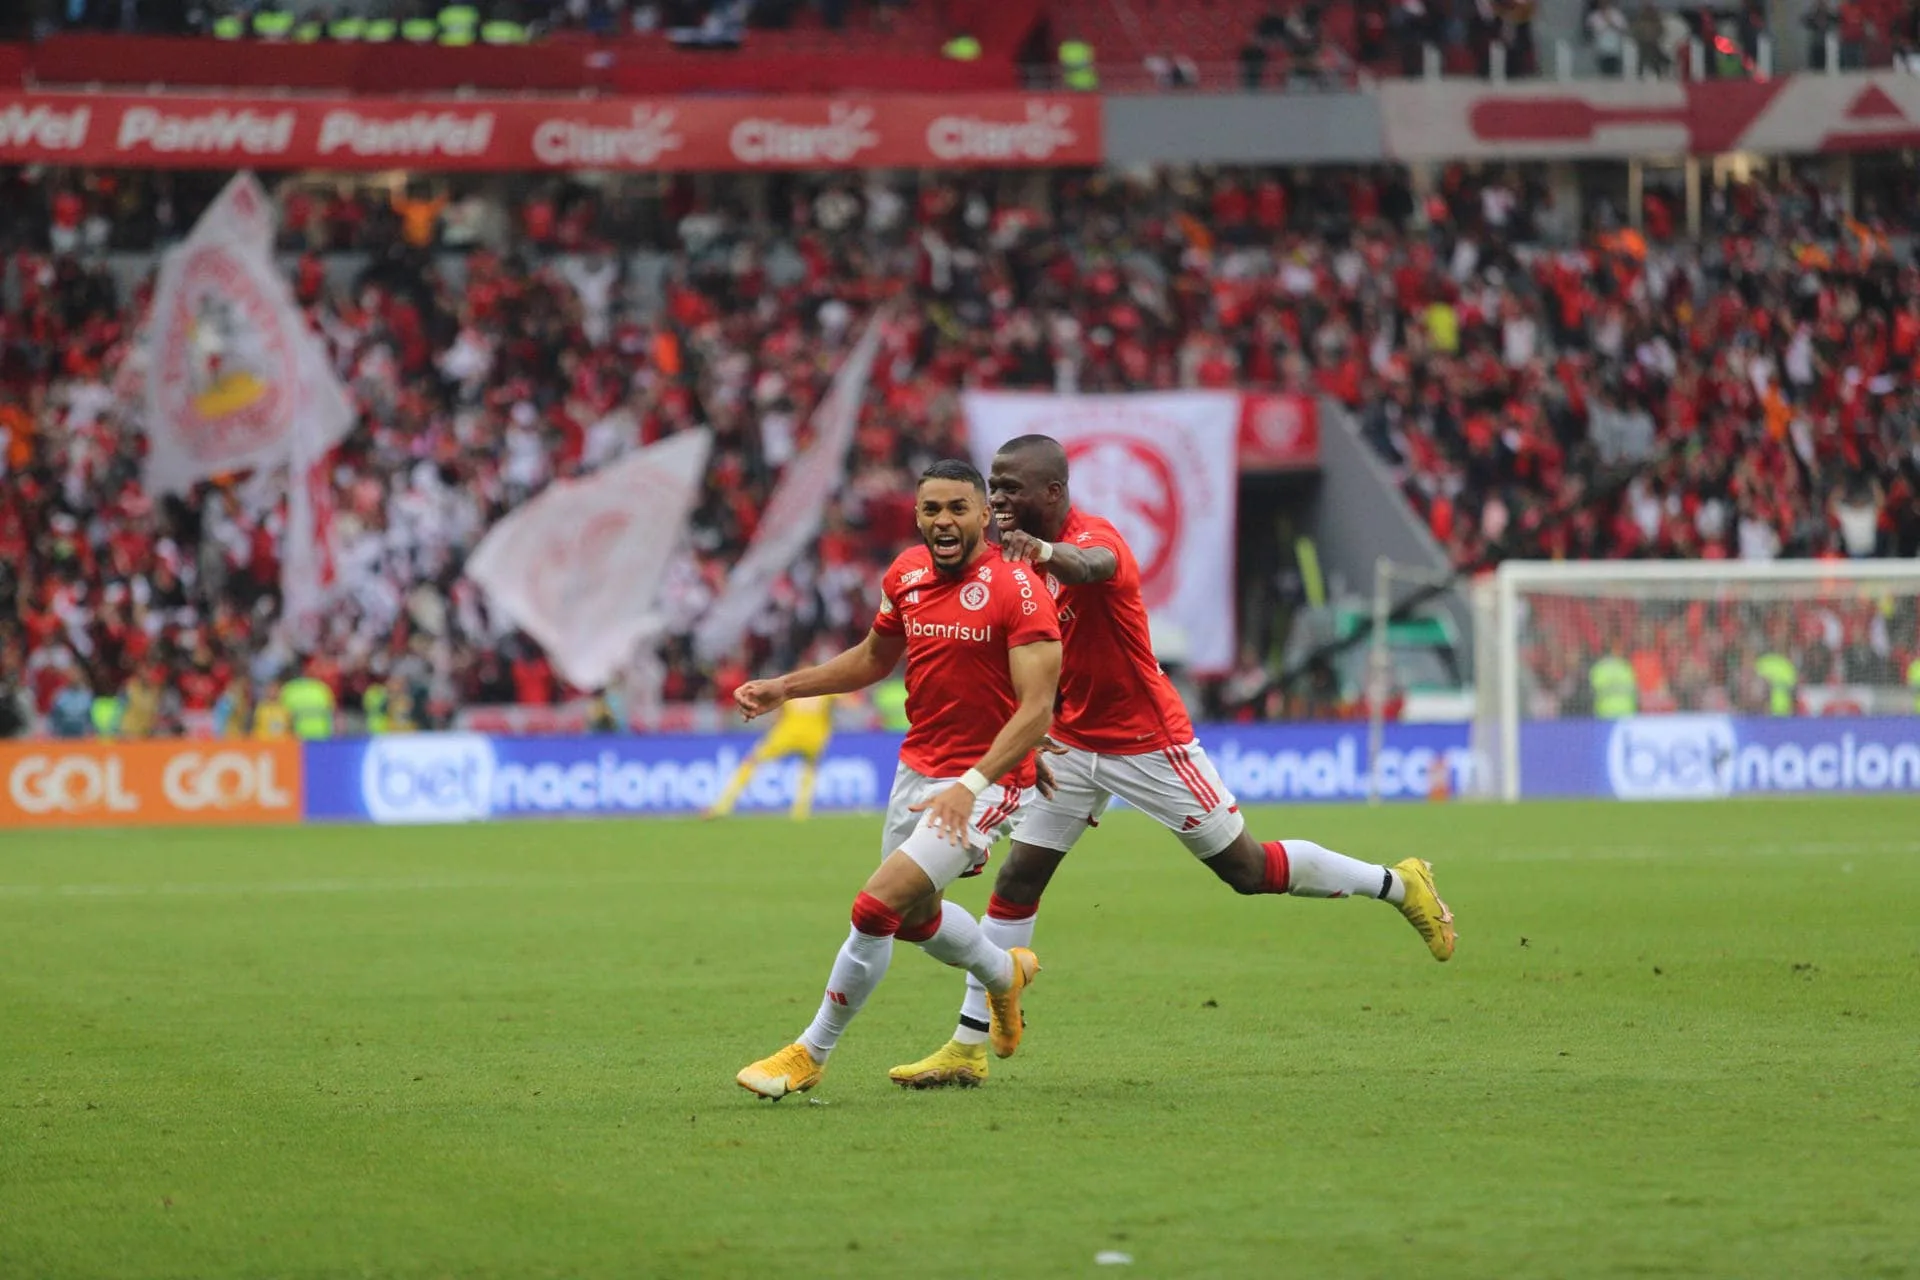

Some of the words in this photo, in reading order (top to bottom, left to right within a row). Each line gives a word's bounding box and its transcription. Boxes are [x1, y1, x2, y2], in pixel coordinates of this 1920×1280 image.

[1012, 568, 1032, 599] vero
[912, 618, 991, 642] banrisul
[9, 754, 139, 813] GOL
[162, 751, 291, 810] GOL
